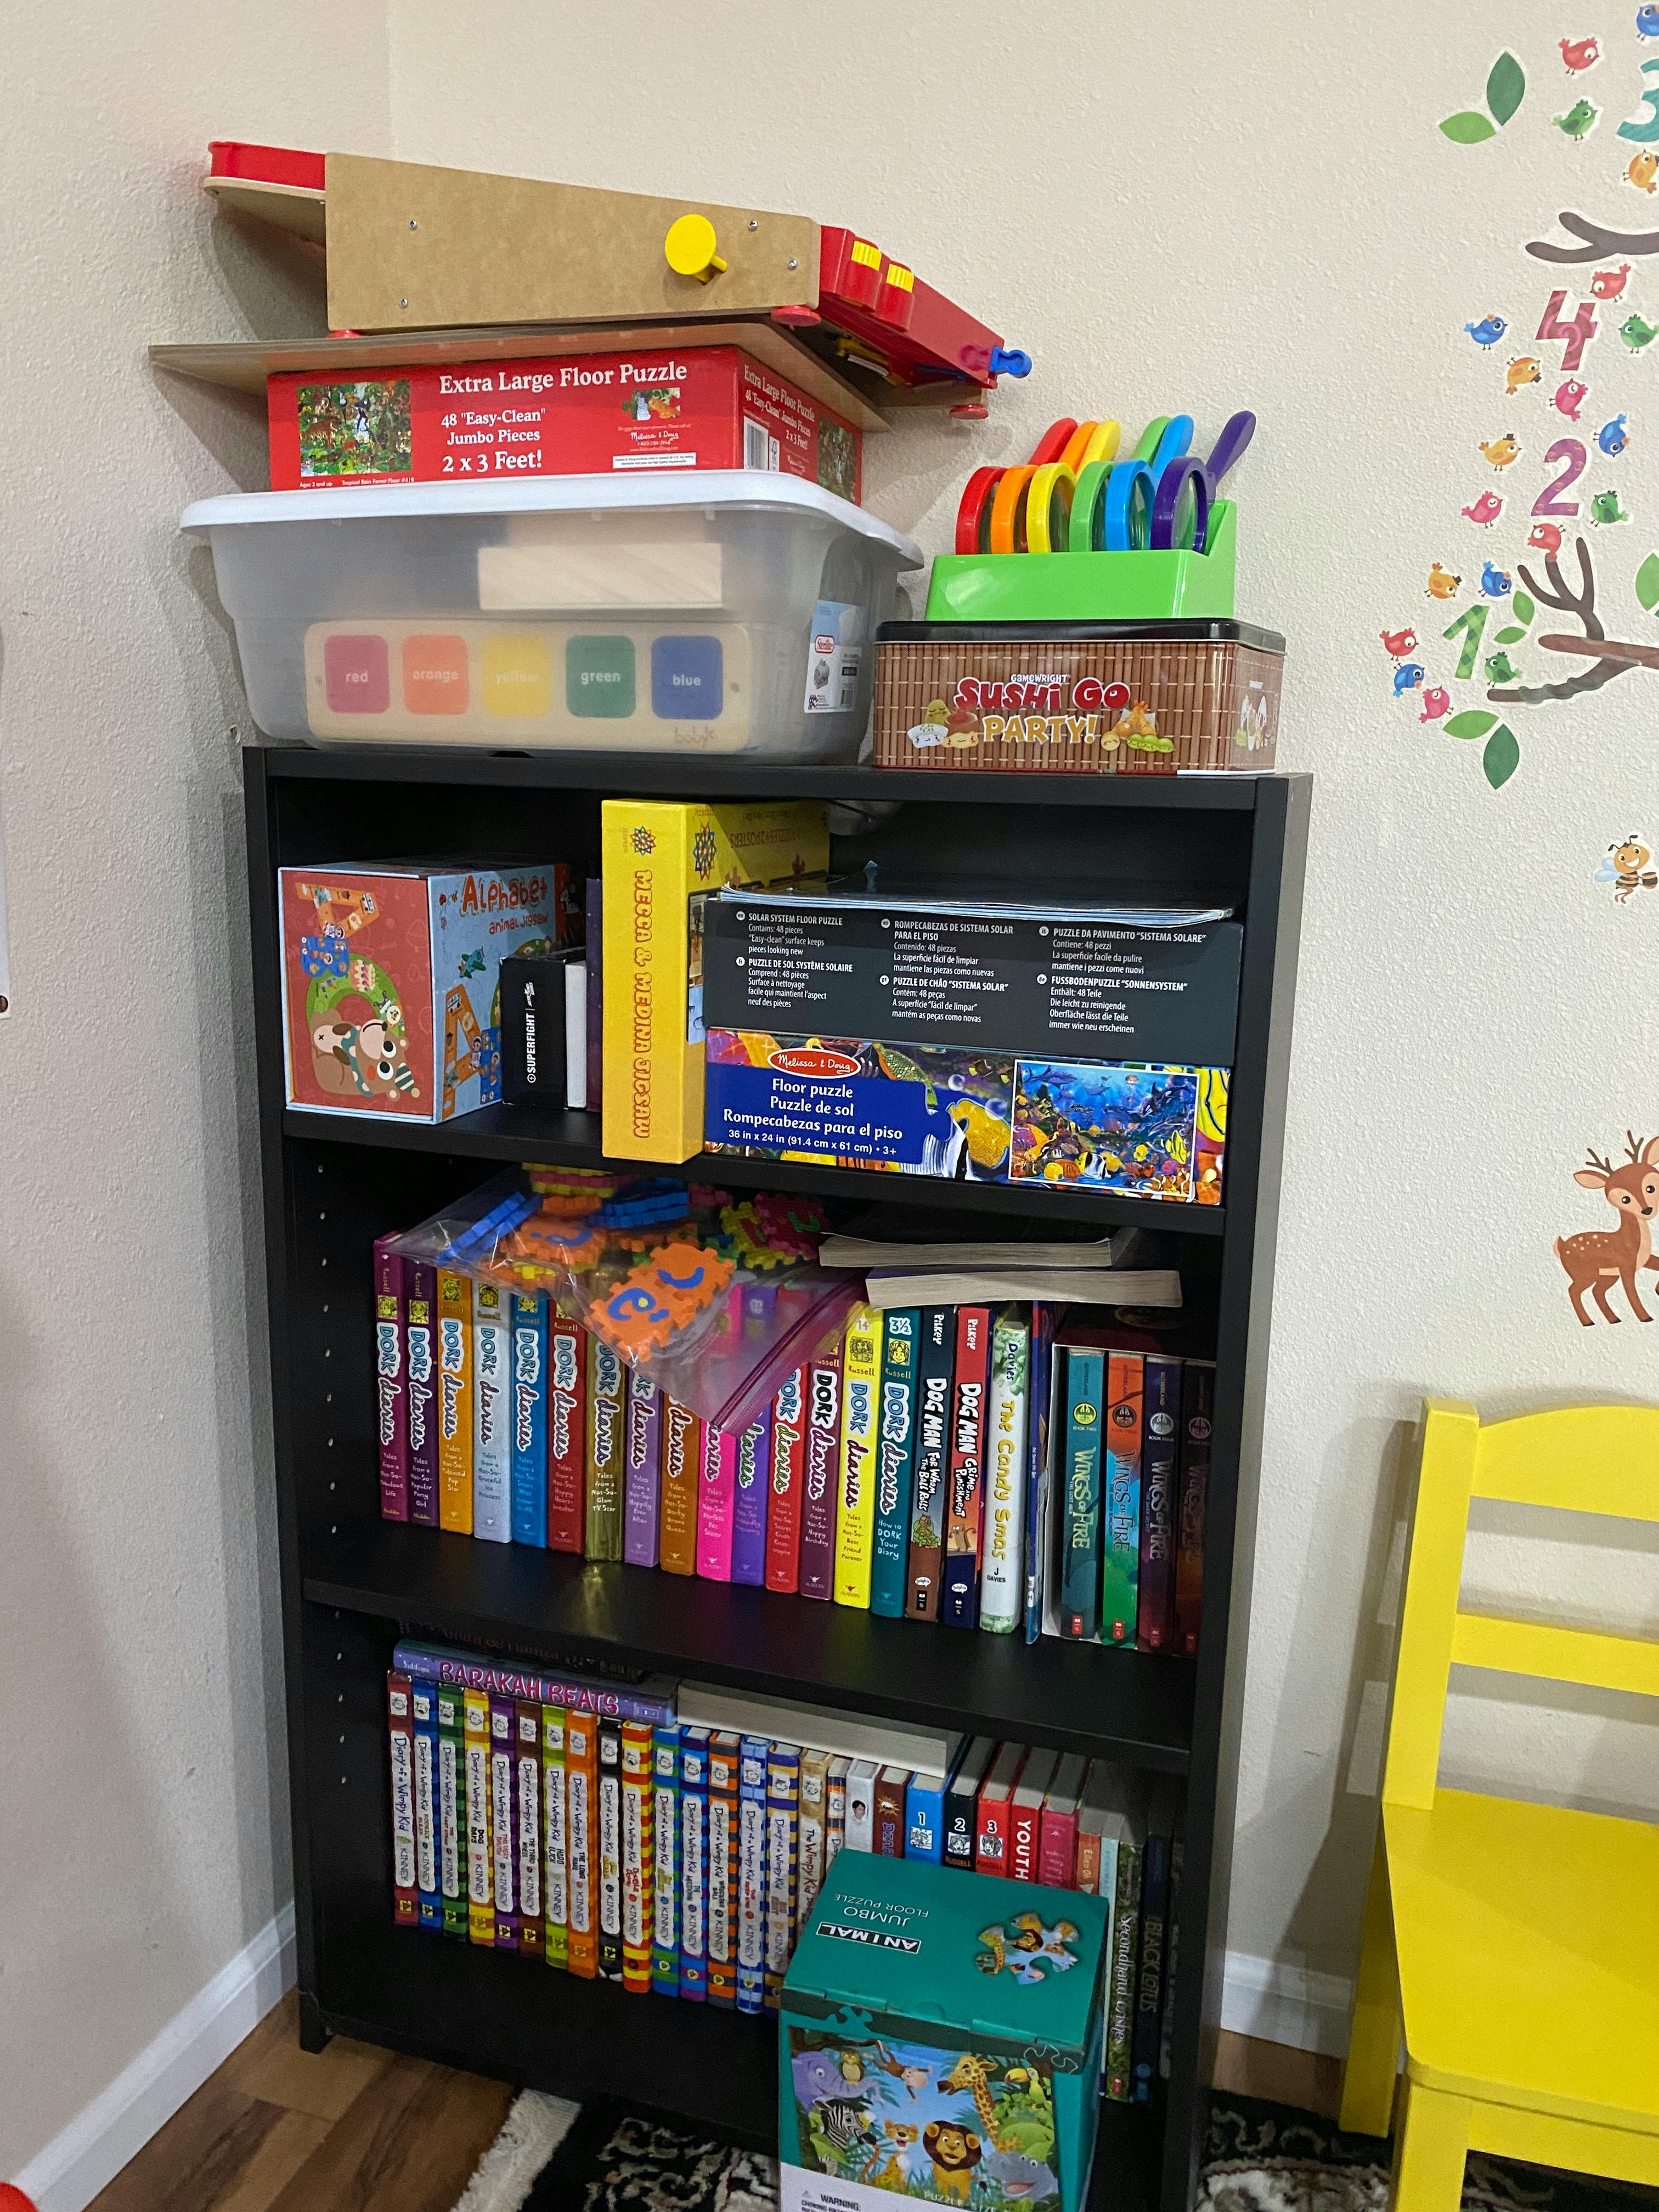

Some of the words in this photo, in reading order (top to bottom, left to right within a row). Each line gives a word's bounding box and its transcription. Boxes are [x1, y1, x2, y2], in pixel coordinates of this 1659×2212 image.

[1536, 290, 1598, 370] 4
[440, 374, 493, 394] Extra
[498, 371, 554, 393] Large
[559, 367, 614, 387] Floor
[619, 360, 687, 383] Puzzle
[744, 364, 761, 389] Extra
[762, 379, 779, 402] Large
[781, 388, 796, 409] Floor
[797, 399, 815, 421] Puzzle
[441, 414, 458, 427] 48
[461, 408, 546, 427] "Easy-Clean"
[447, 431, 494, 445] Jumbo
[498, 430, 540, 443] Pieces
[442, 455, 454, 472] 2
[459, 458, 471, 472] x
[476, 455, 488, 472] 3
[495, 450, 543, 470] Feet!
[1531, 438, 1587, 516] 2
[1442, 605, 1489, 679] 1
[346, 669, 368, 684] red
[413, 668, 458, 683] orange
[581, 670, 620, 686] green
[673, 674, 701, 686] blue
[983, 715, 1098, 744] PARTY!
[636, 870, 652, 942] MECCA
[489, 918, 518, 935] animal
[748, 913, 769, 923] SOLAR
[770, 914, 795, 923] SYSTEM
[797, 915, 816, 924] FLOOR
[817, 916, 843, 926] PUZZLE
[748, 924, 775, 933] Contains:
[785, 927, 803, 935] pieces
[895, 920, 949, 932] ROMPECABEZAS
[950, 923, 958, 932] DE
[960, 923, 990, 934] SISTEMA
[991, 926, 1013, 934] SOLAR
[895, 931, 912, 940] PARA
[914, 932, 921, 940] EL
[923, 933, 939, 941] PISO
[1053, 928, 1079, 938] PUZZLE
[1081, 930, 1091, 938] DA
[1093, 930, 1135, 940] PAVIMENTO
[636, 950, 651, 968] &
[748, 958, 771, 968] PUZZLE
[773, 960, 781, 968] DE
[782, 961, 795, 969] SOL
[796, 960, 825, 970] SYSTÈME
[826, 963, 853, 972] SOLAIRE
[893, 977, 918, 987] PUZZLE
[919, 979, 928, 987] DE
[929, 978, 948, 988] CHÃO
[1051, 988, 1076, 997] Enthält:
[1077, 989, 1086, 997] 48
[1087, 989, 1102, 998] Teile
[1052, 976, 1120, 987] FUSSBODENPUZZLE
[635, 972, 652, 1053] MEDINA
[527, 1013, 535, 1073] SUPERFIGHT
[777, 1054, 816, 1069] Melissa
[820, 1059, 825, 1067] &
[827, 1060, 852, 1074] Doug
[633, 1060, 651, 1138] JIGSAW
[772, 1078, 806, 1094] Floor
[810, 1083, 853, 1099] puzzle
[770, 1096, 812, 1113] Puzzle
[816, 1099, 831, 1114] de
[835, 1102, 854, 1116] sol
[724, 1109, 820, 1132] Rompecabezas
[824, 1122, 855, 1136] para
[859, 1122, 870, 1136] el
[874, 1125, 902, 1141] piso
[729, 1129, 740, 1139] 36
[742, 1130, 752, 1140] in
[761, 1132, 773, 1142] 24
[776, 1133, 785, 1143] in
[787, 1135, 811, 1147] (91.4
[814, 1139, 828, 1148] cm
[839, 1141, 850, 1151] 61
[854, 1143, 872, 1155] cm)
[883, 1146, 896, 1155] 3+
[856, 1318, 869, 1331] 14
[379, 1324, 396, 1373] DORK
[443, 1320, 461, 1370] DORK
[481, 1328, 496, 1375] DORK
[518, 1330, 538, 1381] DORK
[557, 1336, 576, 1389] DORK
[849, 1365, 875, 1376] Russell
[885, 1368, 911, 1379] Russell
[1007, 1342, 1018, 1380] Davies
[443, 1375, 462, 1438] diaries
[924, 1378, 947, 1412] DOG
[958, 1383, 981, 1418] DOG
[380, 1379, 400, 1443] diaries
[481, 1381, 499, 1445] diaries
[518, 1386, 538, 1450] diaries
[851, 1383, 867, 1434] DORK
[885, 1383, 908, 1441] DORK
[999, 1401, 1014, 1432] The
[556, 1392, 575, 1458] diaries
[923, 1413, 943, 1448] MAN
[958, 1419, 978, 1454] MAN
[848, 1438, 868, 1508] diaries
[882, 1442, 907, 1514] diaries
[997, 1440, 1014, 1502] Candy
[1072, 1447, 1096, 1500] WINGS
[878, 1528, 901, 1540] DORK
[879, 1520, 891, 1528] How
[993, 1508, 1011, 1561] Smas
[1072, 1513, 1094, 1548] FIRE
[878, 1548, 899, 1560] Diary
[880, 1538, 899, 1550] Your
[987, 1574, 1006, 1583] DAVIES
[994, 1567, 998, 1576] J
[439, 1661, 541, 1700] BARAKAH
[548, 1681, 619, 1716] BEATS
[394, 1738, 407, 1765] Diary
[396, 1784, 408, 1814] Wimpy
[399, 1816, 410, 1831] Kid
[918, 1812, 926, 1826] 1
[954, 1818, 966, 1832] 2
[987, 1820, 997, 1833] 3
[806, 1829, 815, 1843] The
[801, 1844, 815, 1875] Wimpy
[1017, 1820, 1031, 1880] YOUTH
[400, 1848, 409, 1882] KINNEY
[804, 1878, 817, 1892] Kid
[834, 1893, 881, 1909] PUZZLE
[886, 1903, 929, 1917] FLOOR
[843, 1906, 911, 1927] JUMBO
[825, 1924, 918, 1950] ANIMAL
